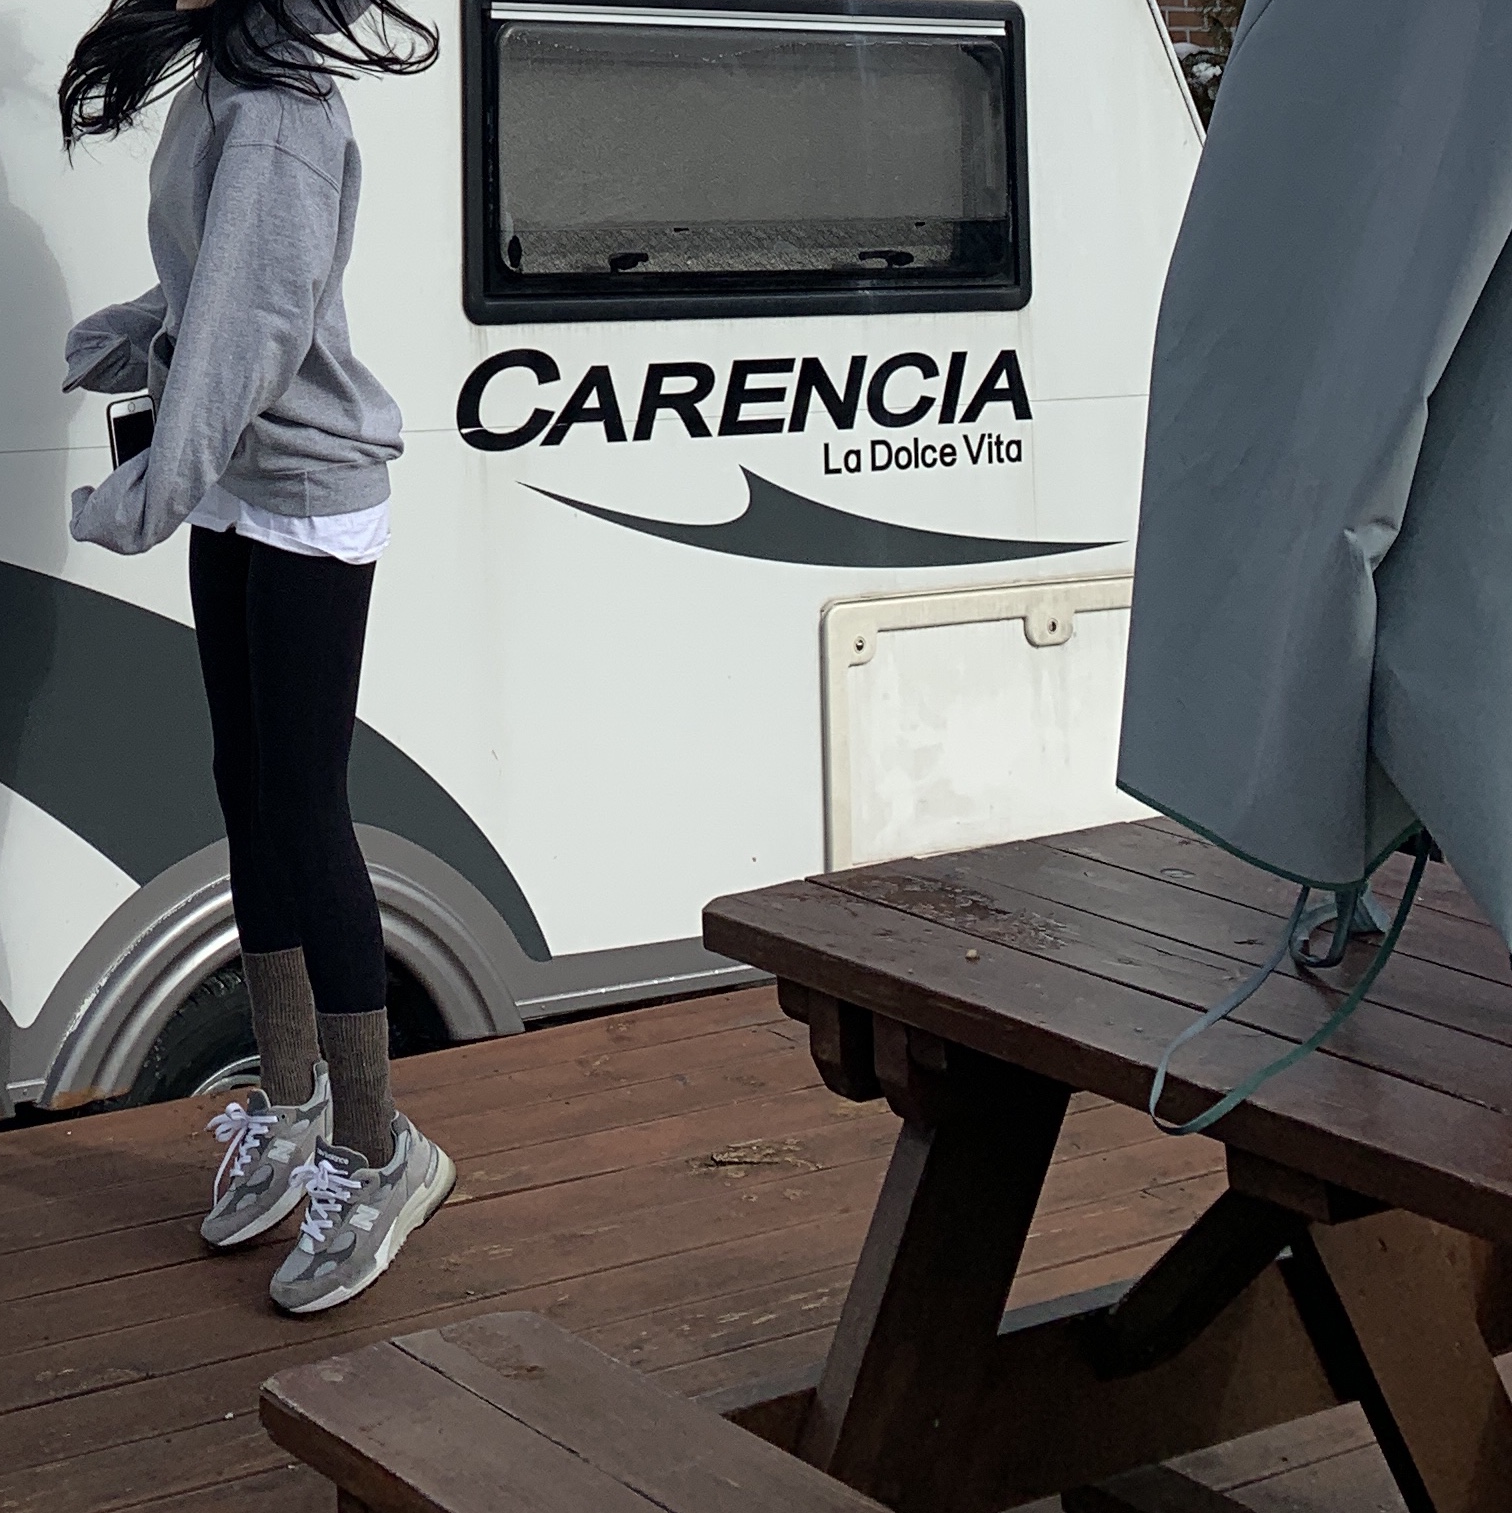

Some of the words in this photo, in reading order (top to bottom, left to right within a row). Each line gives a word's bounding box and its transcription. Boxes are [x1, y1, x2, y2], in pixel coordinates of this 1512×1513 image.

[456, 348, 1033, 452] CARENCIA
[823, 442, 862, 475] La
[870, 437, 957, 472] Dolce
[962, 432, 1022, 465] Vita
[267, 1139, 298, 1164] N
[348, 1203, 382, 1231] N
